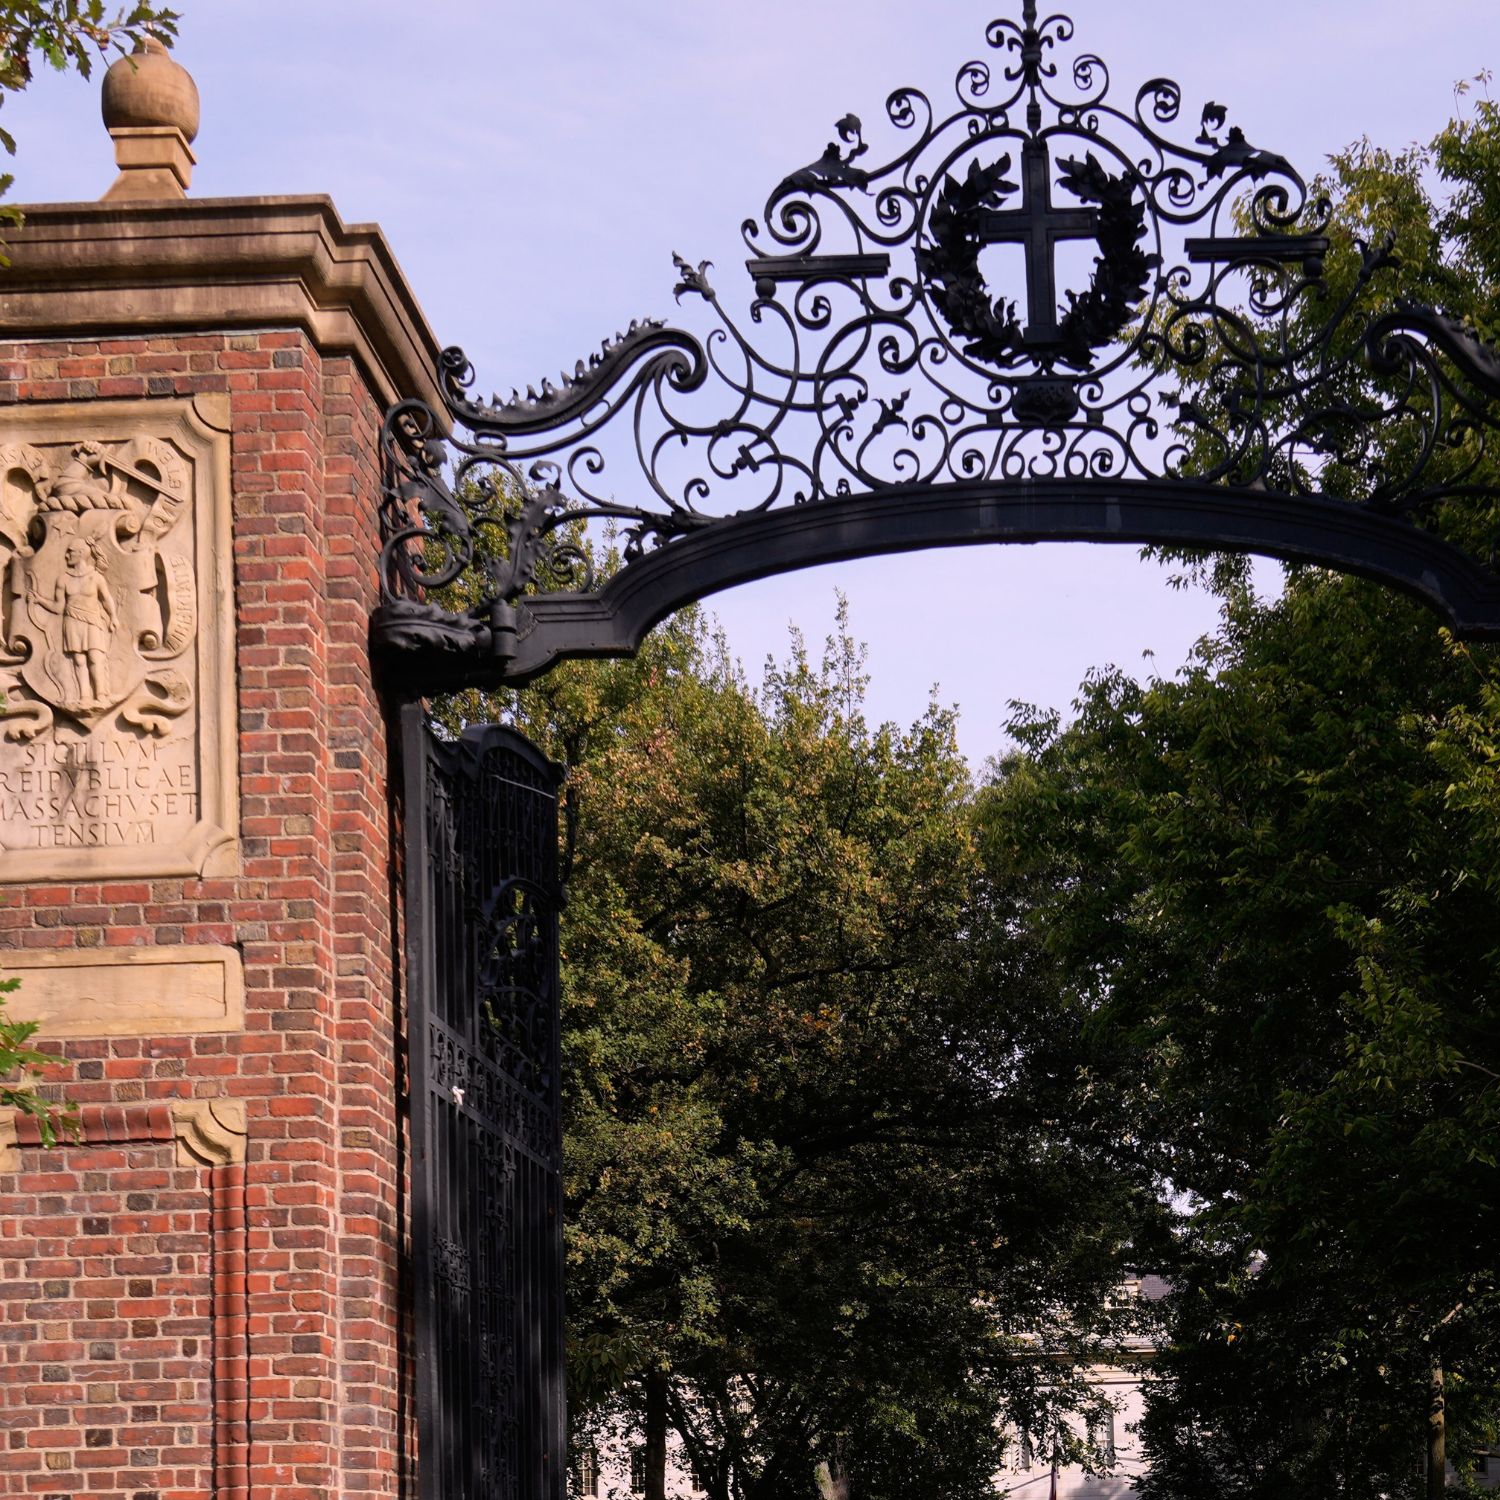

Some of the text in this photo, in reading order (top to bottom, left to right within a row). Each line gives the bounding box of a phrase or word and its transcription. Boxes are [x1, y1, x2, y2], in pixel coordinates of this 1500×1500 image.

[982, 429, 1092, 480] 1636
[24, 741, 158, 766] SIGILLVM
[0, 792, 199, 822] ASSACHVSET
[31, 821, 156, 847] TENSIVM
